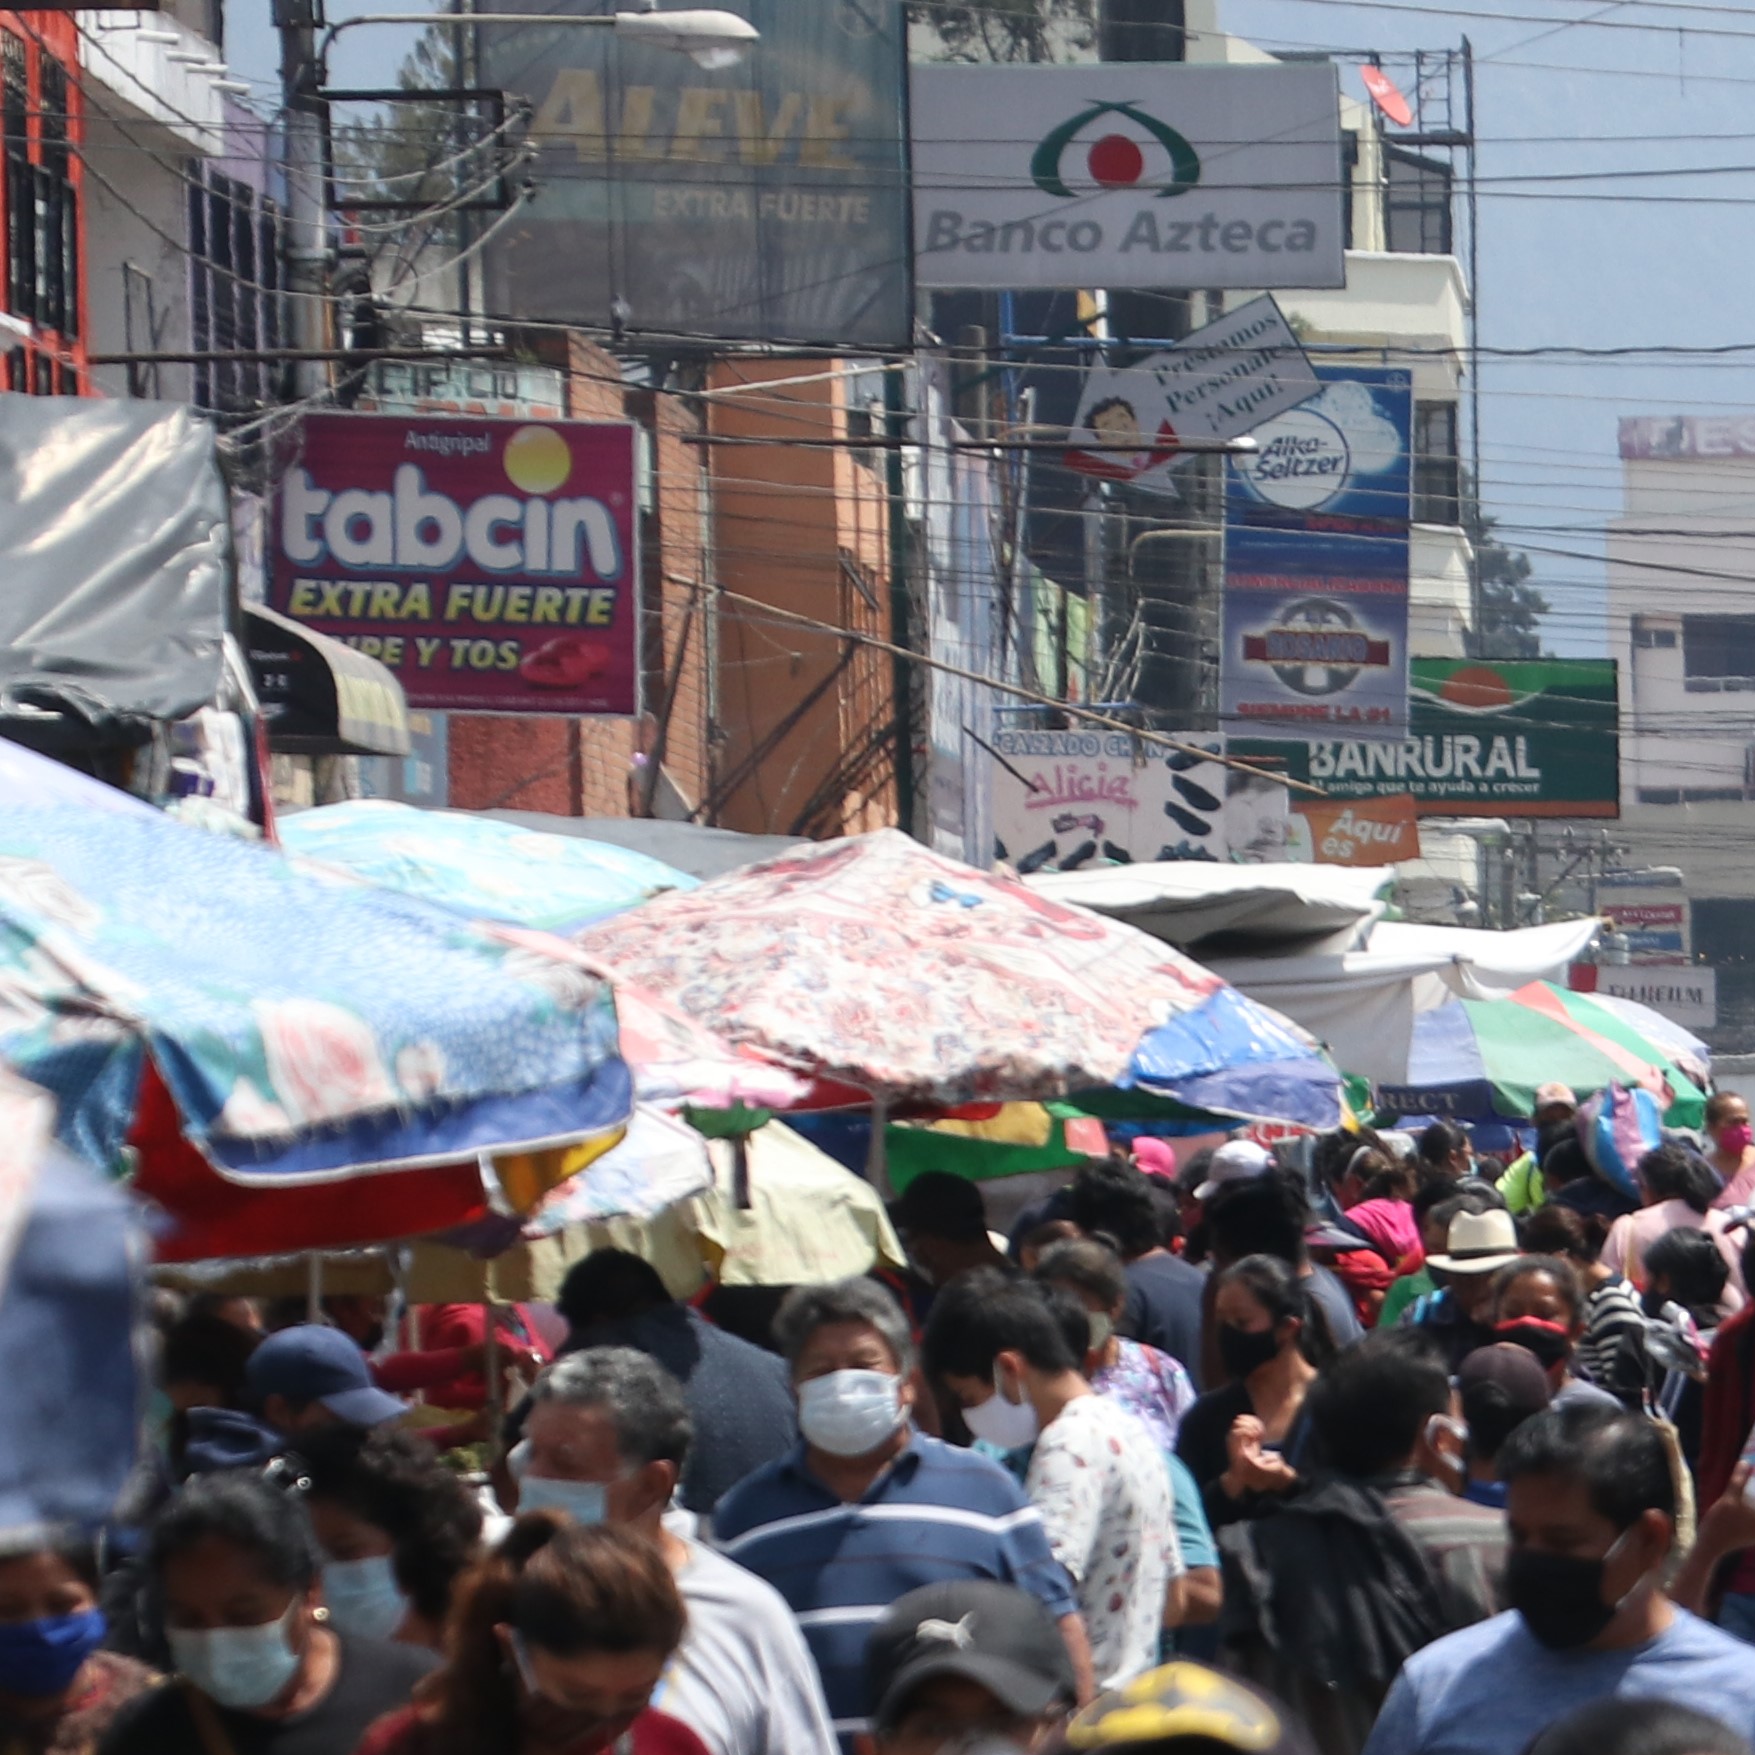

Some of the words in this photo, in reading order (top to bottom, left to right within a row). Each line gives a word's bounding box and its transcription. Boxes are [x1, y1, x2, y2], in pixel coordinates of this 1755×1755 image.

[528, 69, 860, 167] ALEVE
[654, 190, 749, 218] EXTRA
[760, 194, 869, 224] FUERTE
[925, 209, 1103, 253] Banco
[1118, 209, 1317, 253] Azteca
[404, 430, 491, 456] Antigripal
[1262, 435, 1328, 458] Alka-
[1253, 454, 1344, 481] Seltzer
[282, 462, 623, 580] tabcin
[288, 577, 432, 621] EXTRA
[444, 584, 616, 626] FUERTE
[415, 637, 442, 667] Y
[450, 639, 521, 671] TOS
[1001, 732, 1100, 758] CALZADO
[1308, 734, 1541, 778] BANRURAL
[1026, 761, 1130, 798] Alicia
[1326, 780, 1374, 795] amigo
[1376, 781, 1406, 795] que
[1408, 781, 1426, 793] te
[1427, 780, 1475, 795] ayuda
[1478, 783, 1488, 793] a
[1491, 782, 1541, 793] crecer
[1321, 836, 1355, 857] es
[1381, 1090, 1459, 1112] RECT
